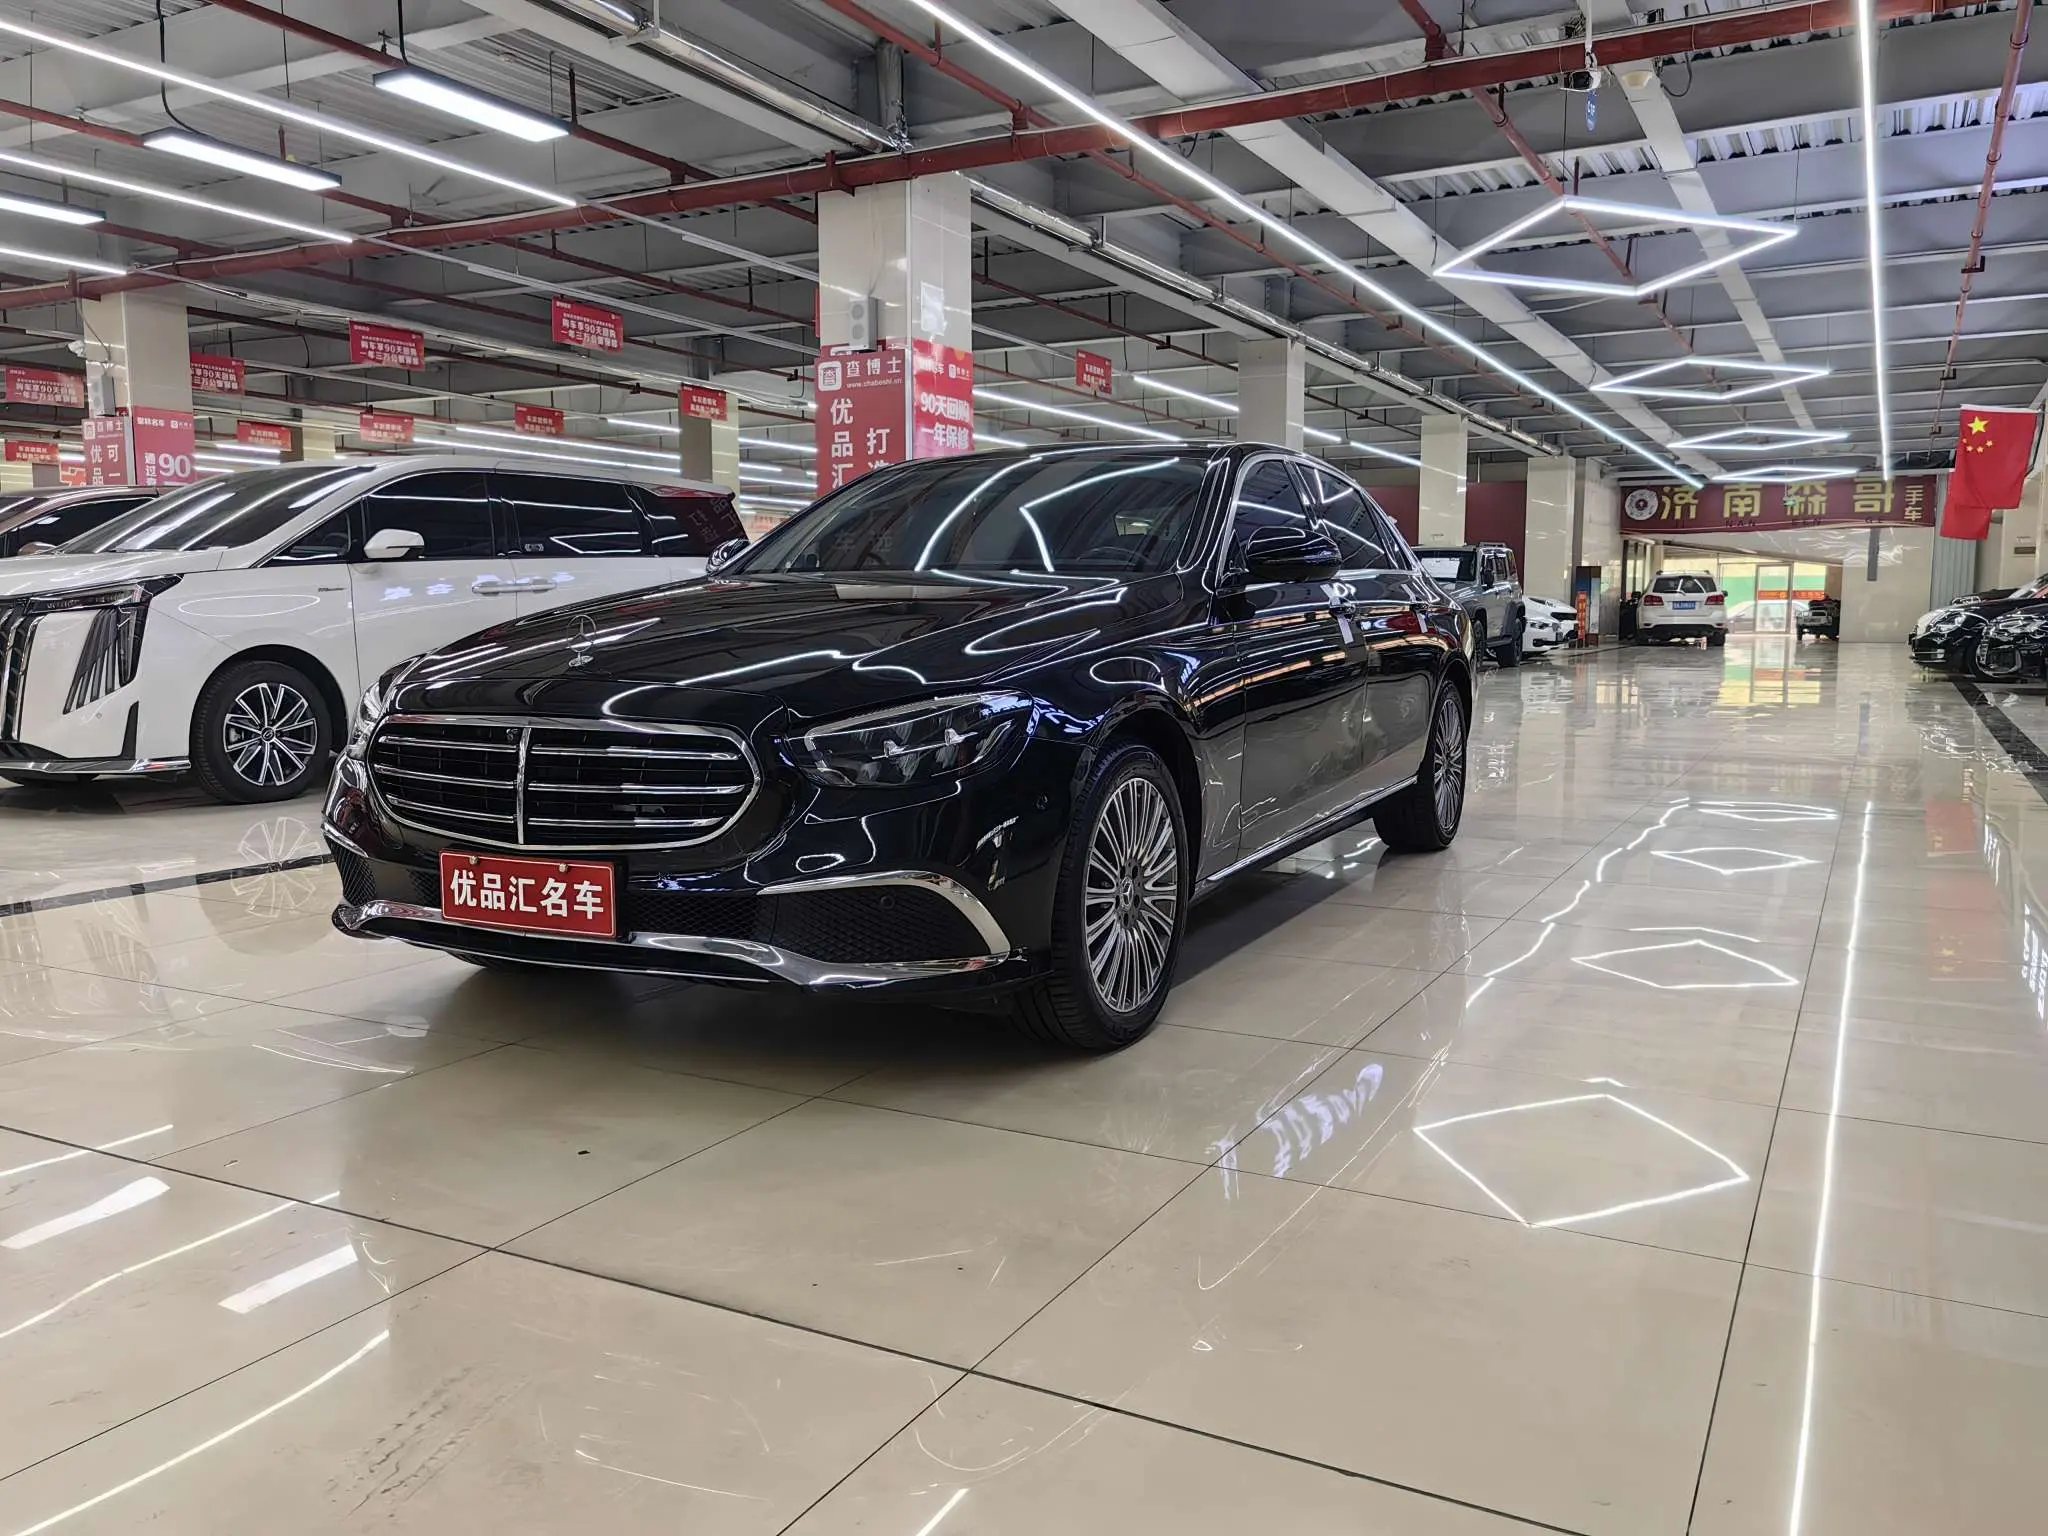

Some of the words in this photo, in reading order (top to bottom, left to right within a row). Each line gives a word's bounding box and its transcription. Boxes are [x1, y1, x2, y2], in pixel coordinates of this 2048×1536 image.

[846, 356, 901, 378] 查博士
[920, 392, 970, 423] 90天回购
[830, 398, 854, 490] 优品汇
[920, 423, 970, 450] 一年保修
[159, 453, 192, 478] 90
[1903, 485, 1924, 522] 二手车
[450, 869, 604, 920] 优品汇名车
